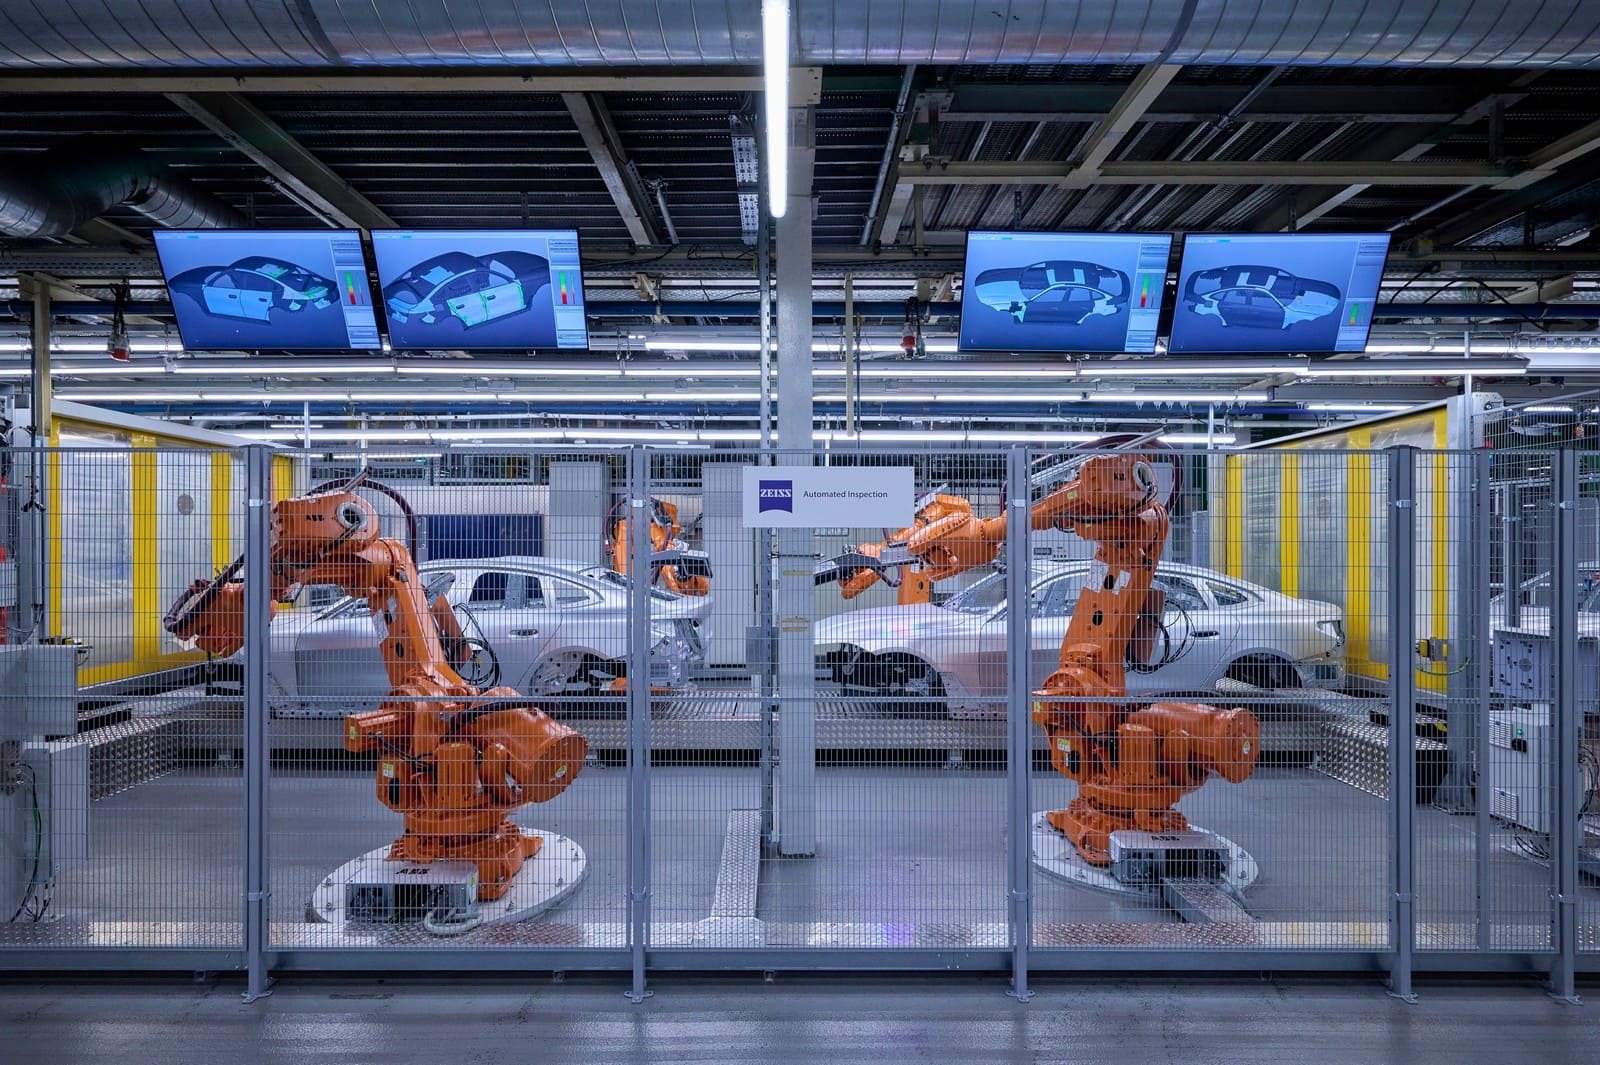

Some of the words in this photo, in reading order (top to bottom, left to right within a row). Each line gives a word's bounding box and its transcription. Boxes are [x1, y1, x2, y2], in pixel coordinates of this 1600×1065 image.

[760, 489, 792, 498] ZEISS
[803, 490, 846, 498] Automated
[848, 490, 888, 500] Inspection
